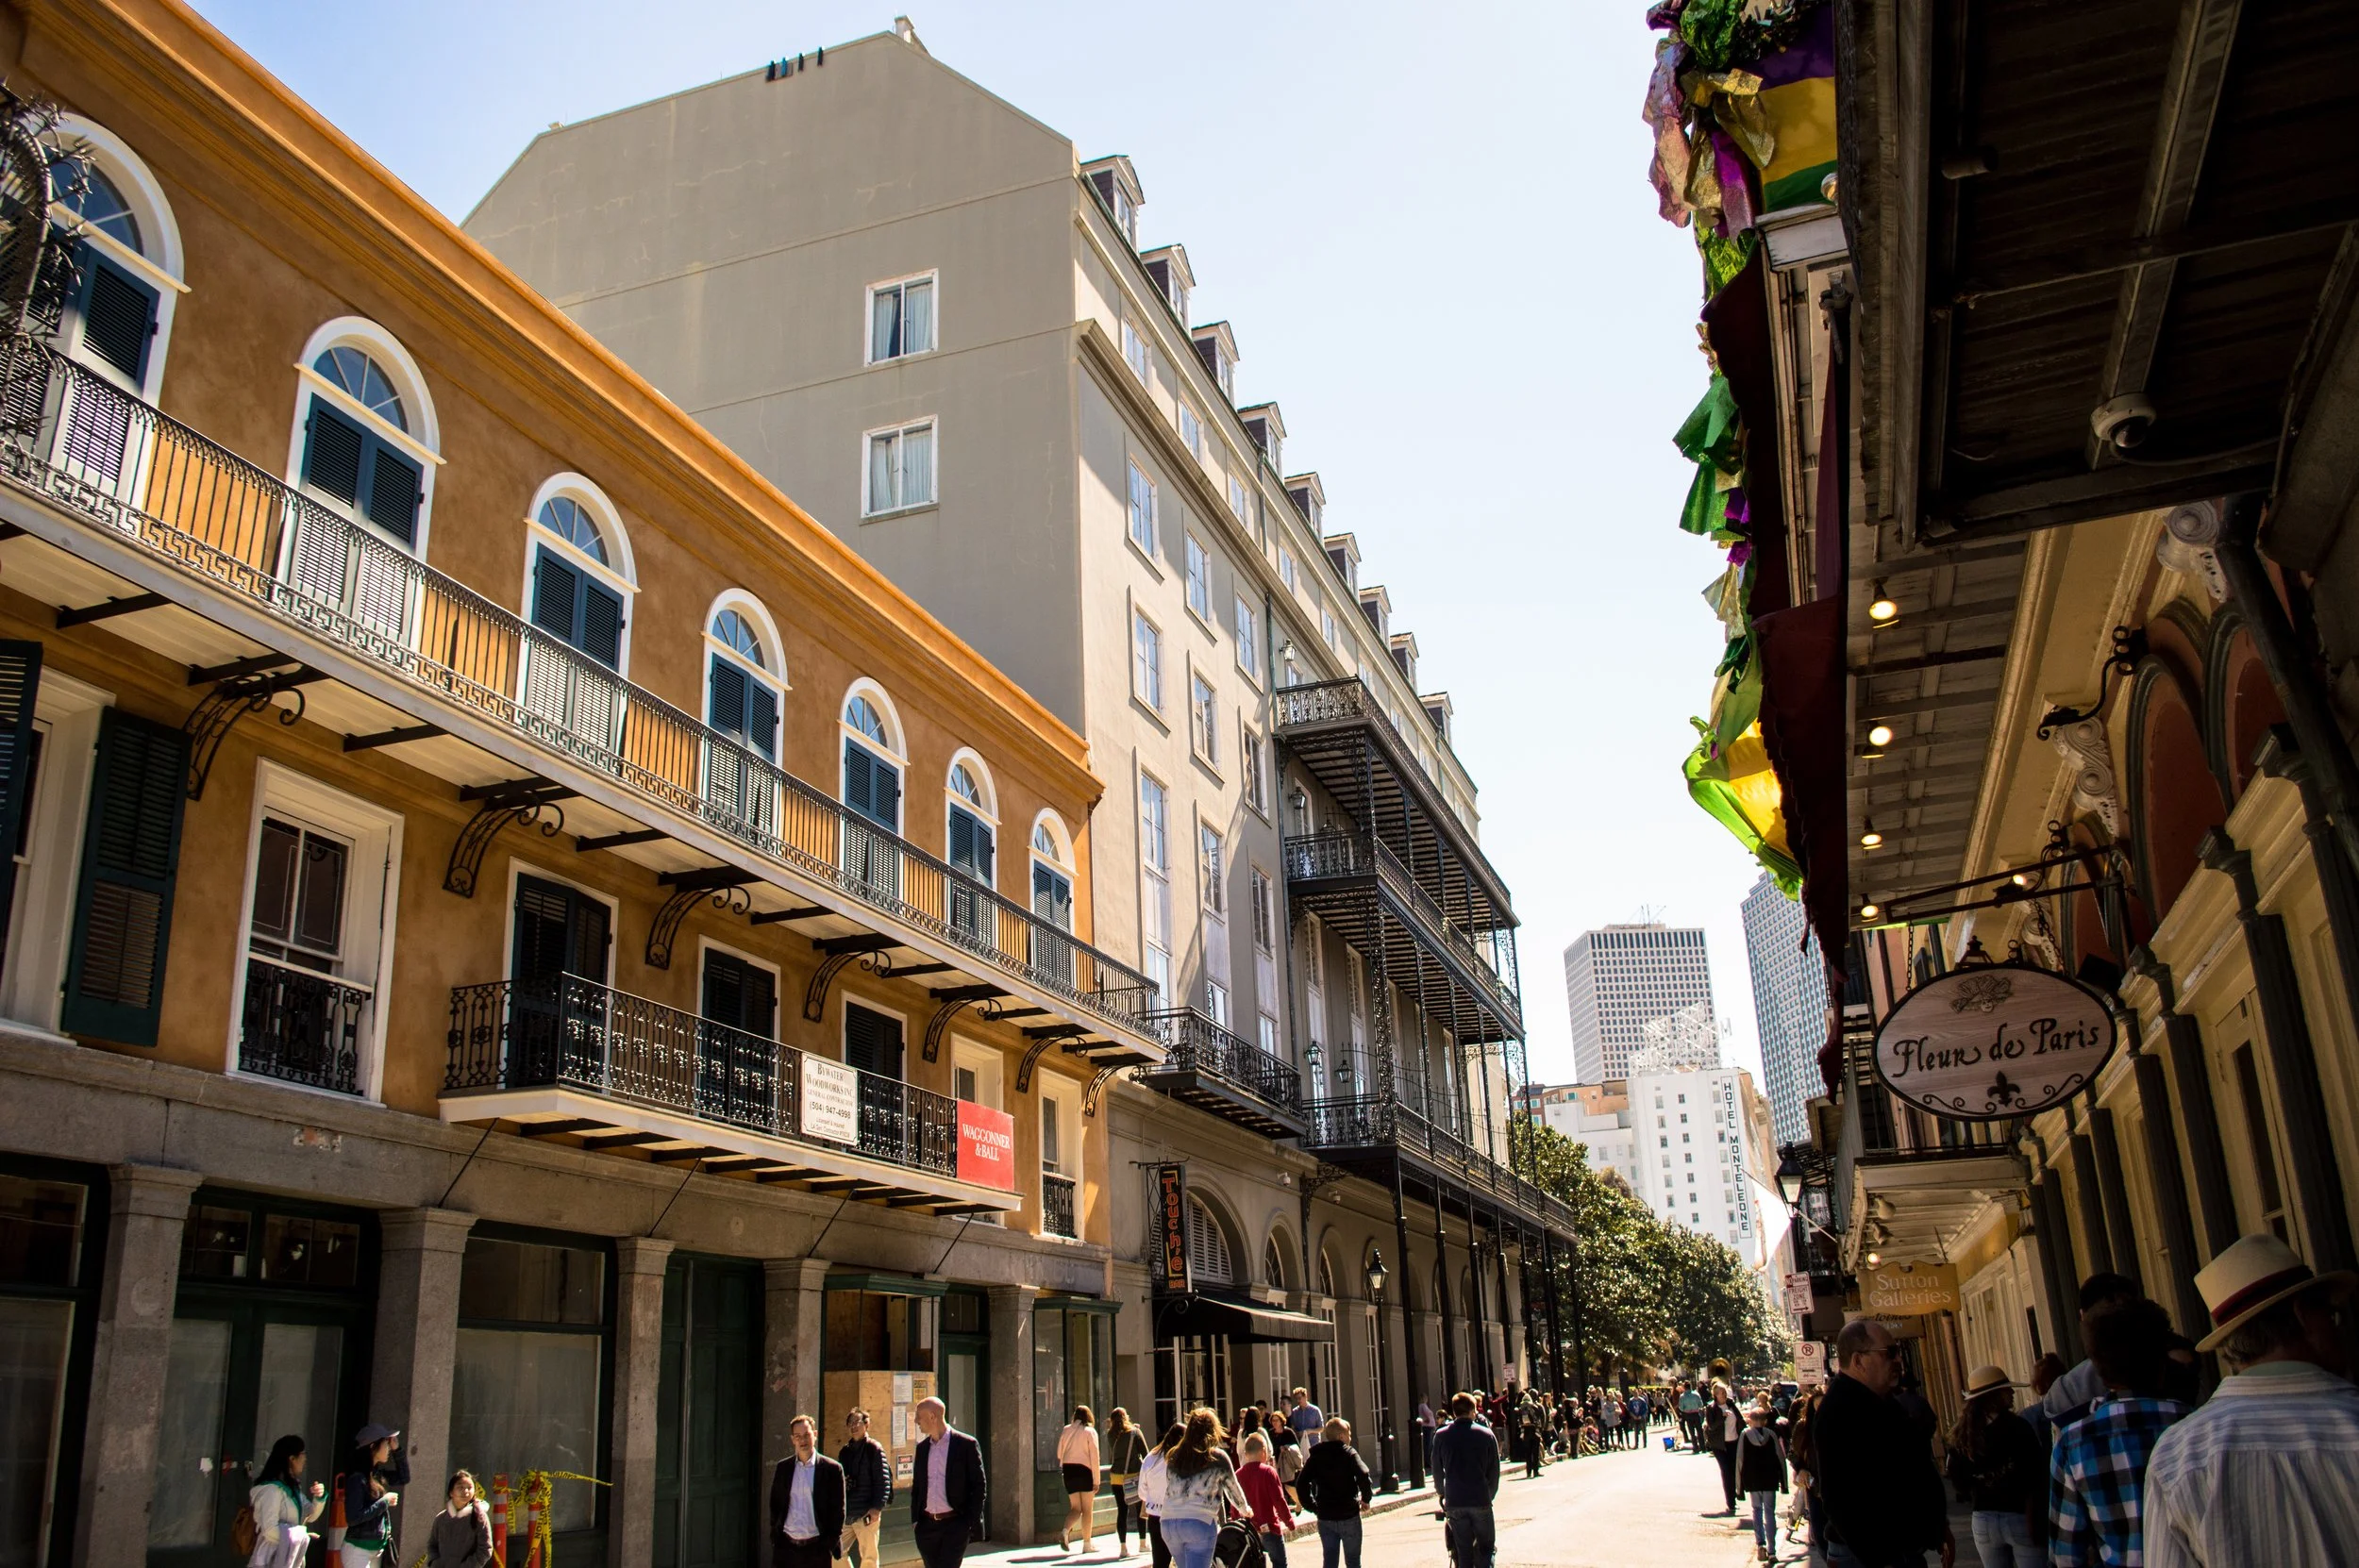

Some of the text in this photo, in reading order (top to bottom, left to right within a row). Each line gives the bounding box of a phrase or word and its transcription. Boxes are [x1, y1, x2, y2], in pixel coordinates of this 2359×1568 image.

[1892, 1017, 2100, 1078] Fleur de Paris
[806, 1073, 844, 1094] WOODWORKS
[962, 1123, 1011, 1149] WAGGONNER
[1723, 1082, 1748, 1231] HOTEL MONTELEONE
[1168, 1278, 1185, 1289] BAR
[1876, 1274, 1939, 1291] Sutton
[1868, 1290, 1952, 1308] Galleries
